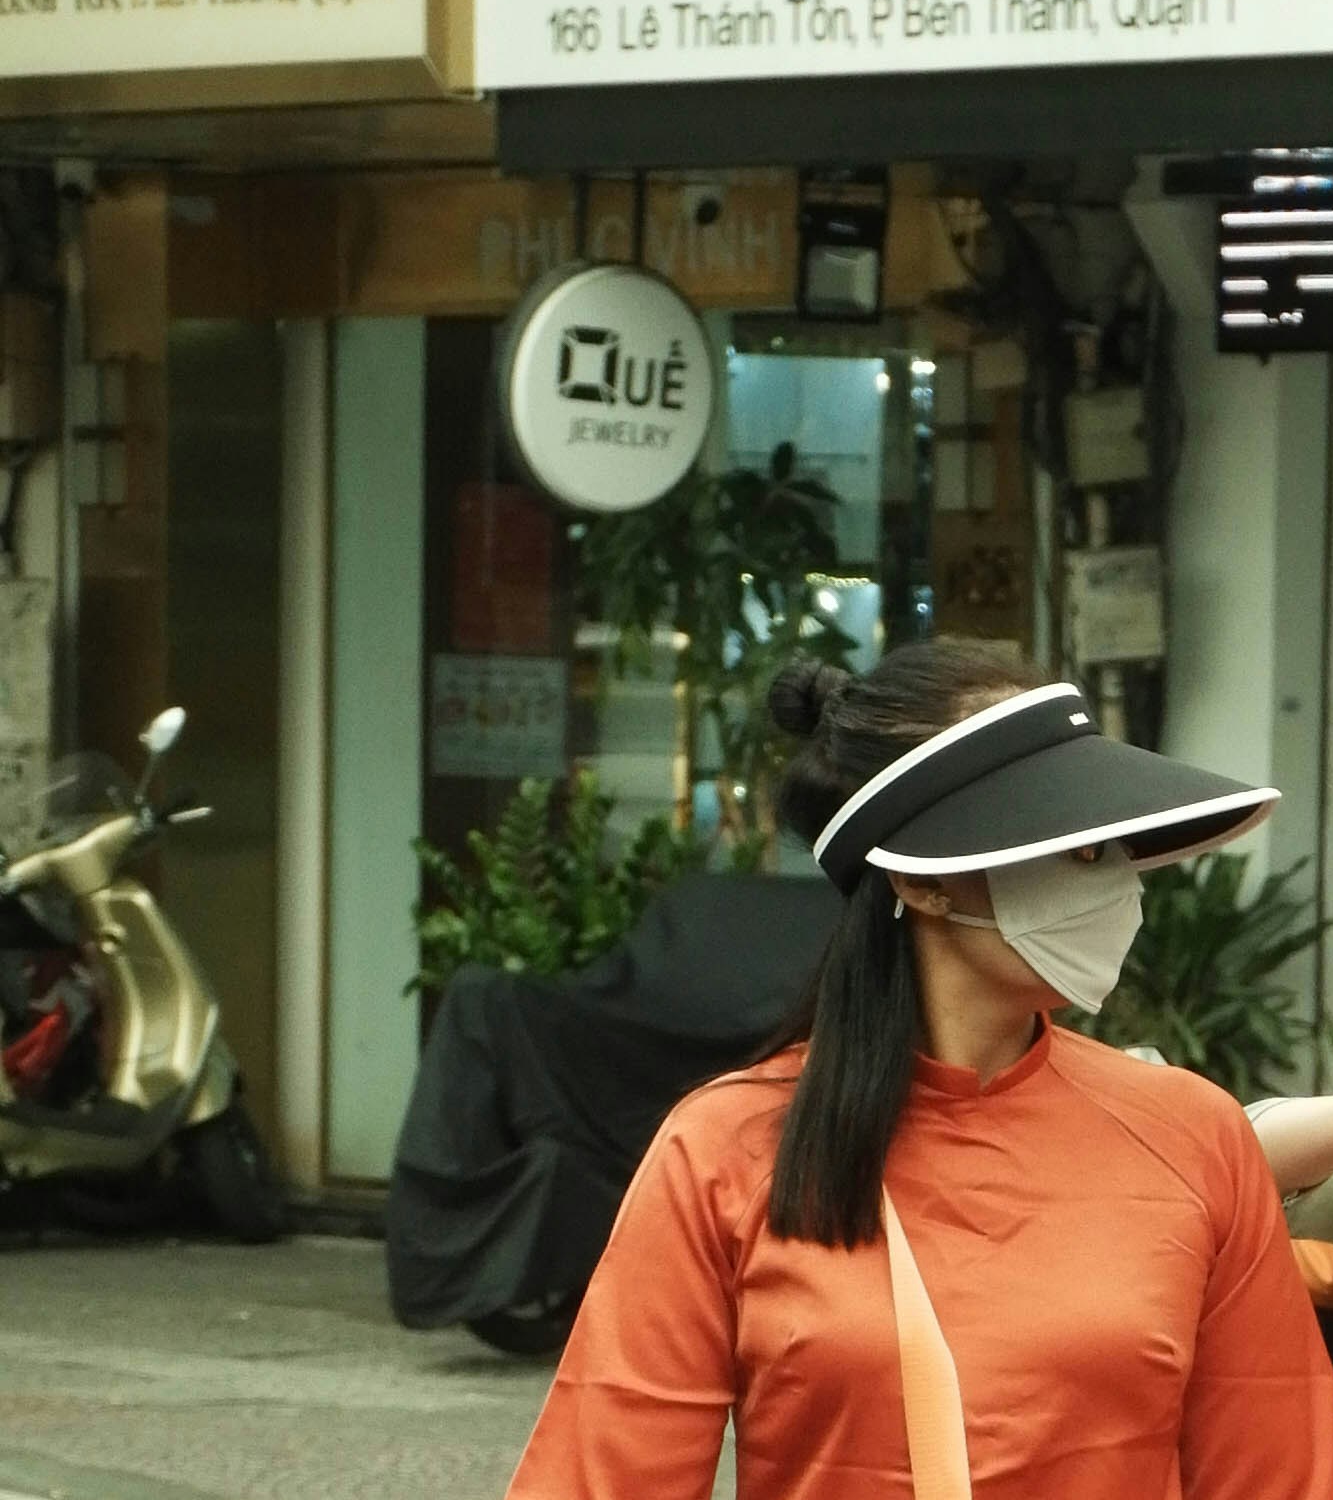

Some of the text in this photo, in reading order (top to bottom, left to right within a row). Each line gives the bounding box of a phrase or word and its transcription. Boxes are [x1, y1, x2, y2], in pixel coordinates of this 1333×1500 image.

[549, 6, 601, 54] 166
[617, 5, 660, 51] Lê
[671, 0, 777, 49] Thánh
[568, 417, 674, 450] JEWELRY
